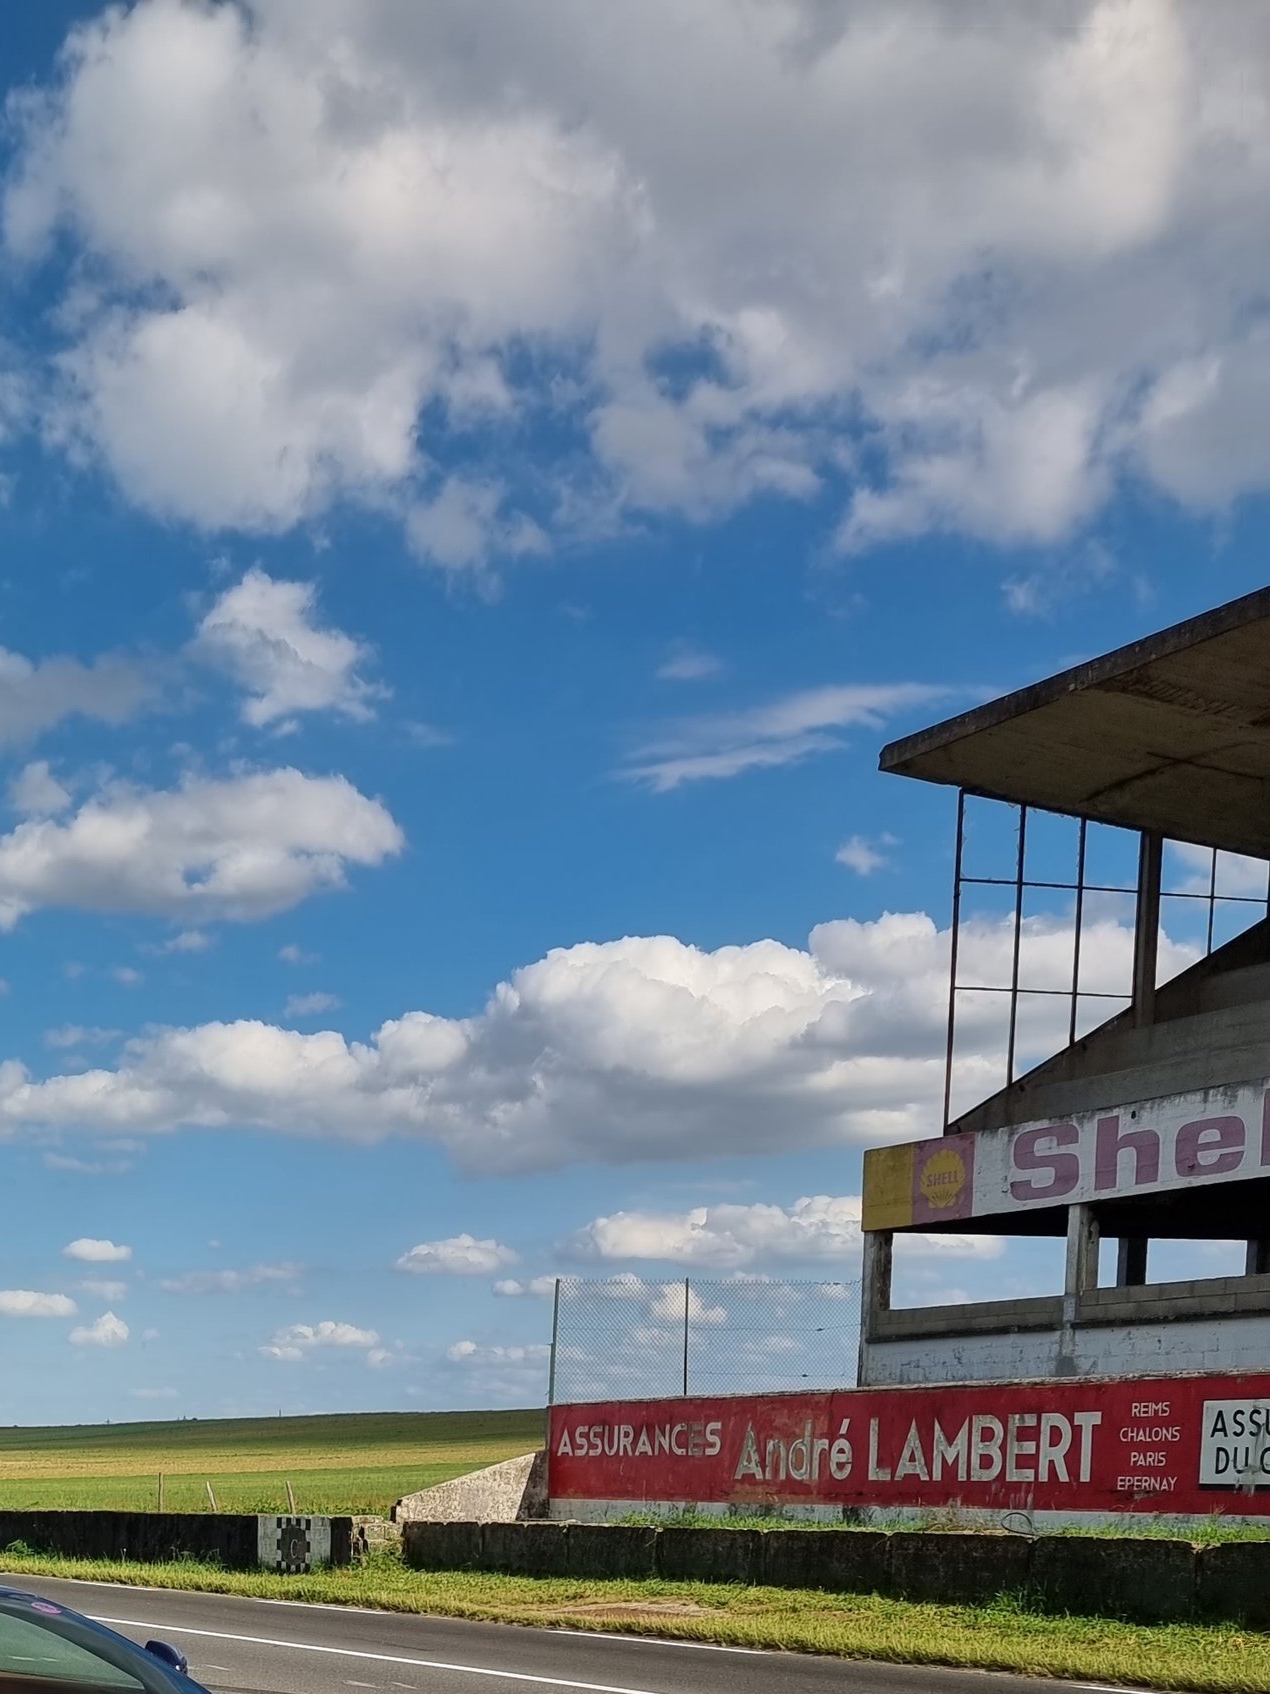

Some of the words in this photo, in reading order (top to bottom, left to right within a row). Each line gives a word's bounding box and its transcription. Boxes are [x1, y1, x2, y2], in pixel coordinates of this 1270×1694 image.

[927, 1170, 959, 1188] SHELL
[1131, 1401, 1171, 1418] REIMS
[1119, 1426, 1182, 1442] CHALONS
[556, 1421, 723, 1457] ASSURANCES
[734, 1418, 853, 1481] André
[868, 1411, 1103, 1483] LAMBERT
[1130, 1451, 1167, 1467] PARIS
[1214, 1446, 1250, 1475] DU
[1116, 1475, 1178, 1491] EPERNAY
